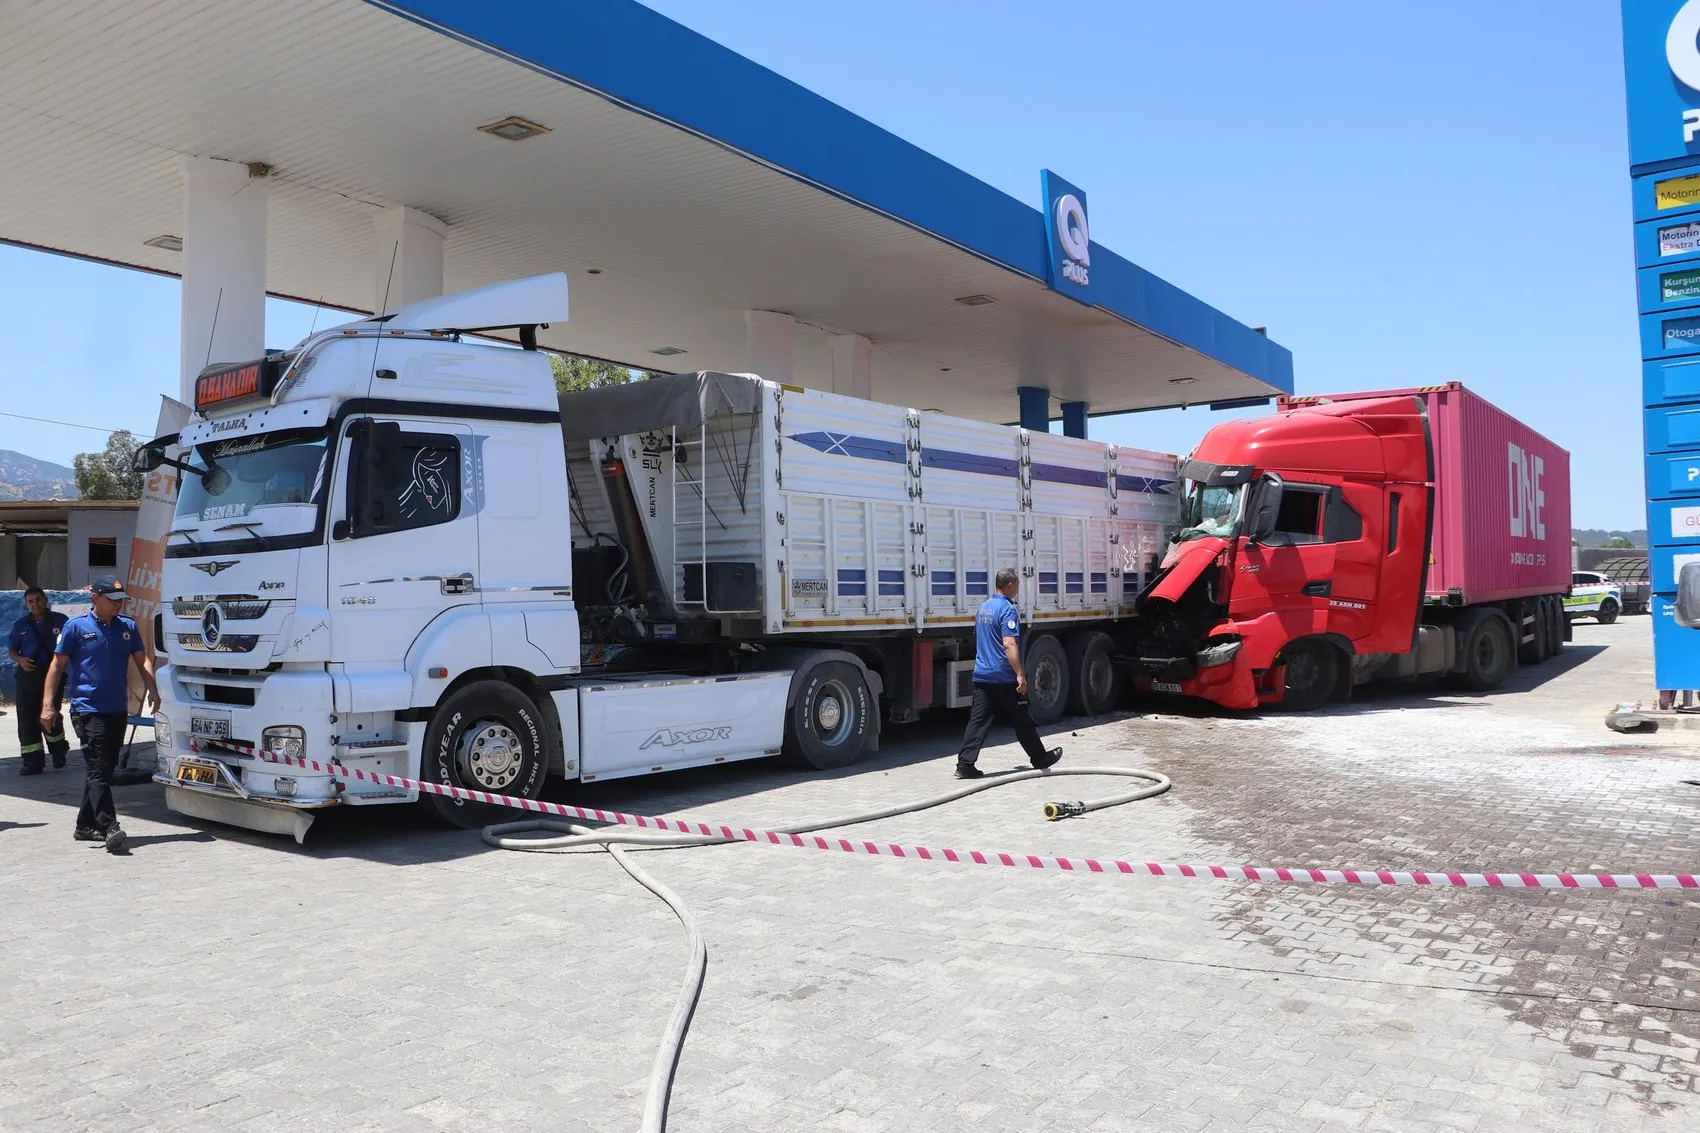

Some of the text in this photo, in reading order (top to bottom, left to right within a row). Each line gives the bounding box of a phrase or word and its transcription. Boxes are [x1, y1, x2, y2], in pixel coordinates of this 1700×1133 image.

[1056, 194, 1090, 267] Q
[1662, 230, 1699, 240] Motorin
[1663, 241, 1693, 250] Ekstra
[1062, 259, 1089, 286] PLUS
[1664, 287, 1700, 298] Benzin
[212, 418, 246, 433] TALHA
[1688, 467, 1700, 481] P
[1507, 441, 1545, 540] ONE
[203, 503, 246, 519] SENAM
[801, 582, 828, 591] MERTCAN
[518, 708, 540, 757] REGIONAL
[639, 726, 733, 751] AXOR
